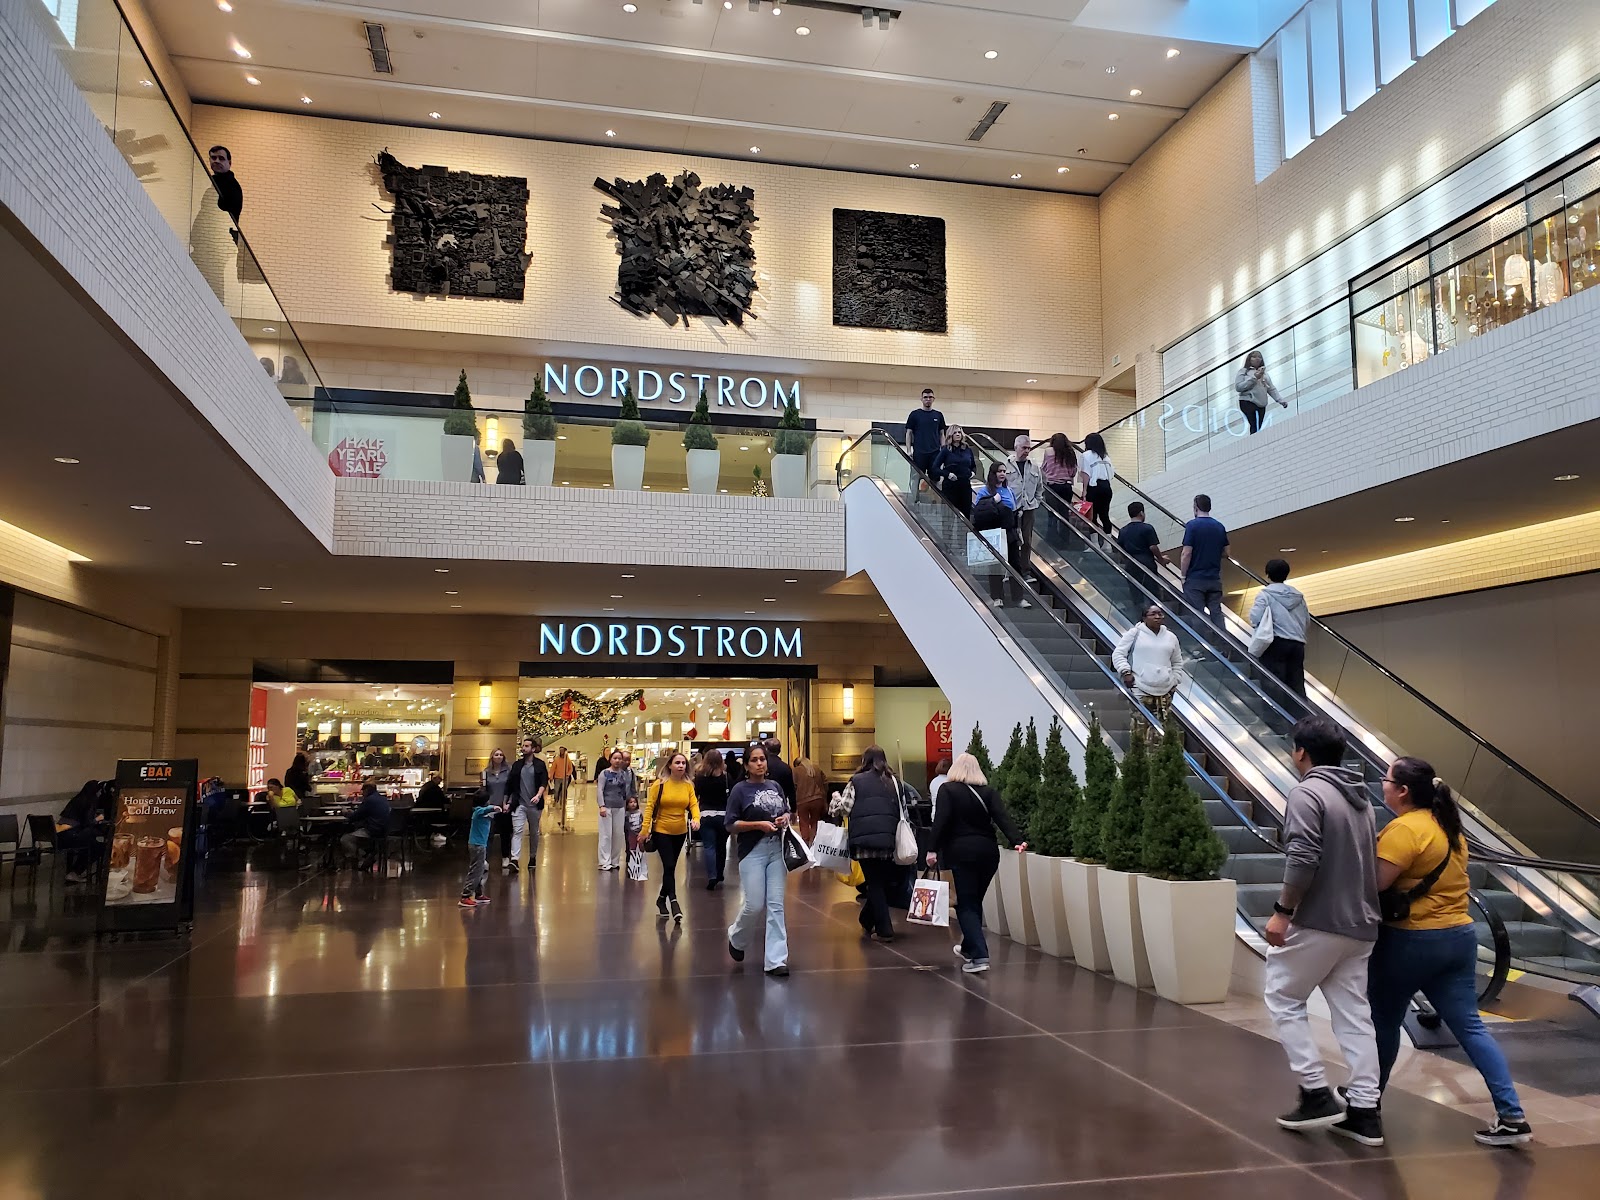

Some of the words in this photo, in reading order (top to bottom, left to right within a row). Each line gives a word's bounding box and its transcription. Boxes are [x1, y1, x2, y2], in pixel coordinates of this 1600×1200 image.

[544, 362, 801, 410] NORDSTROM
[345, 437, 384, 449] HALF
[337, 448, 389, 462] YEARLY
[345, 461, 382, 474] SALE
[539, 622, 802, 658] NORDSTROM
[140, 766, 172, 777] EBAR
[124, 796, 154, 805] House
[156, 796, 182, 805] Made
[127, 805, 151, 815] Cold
[152, 806, 177, 815] Brew
[817, 844, 838, 857] STEVE
